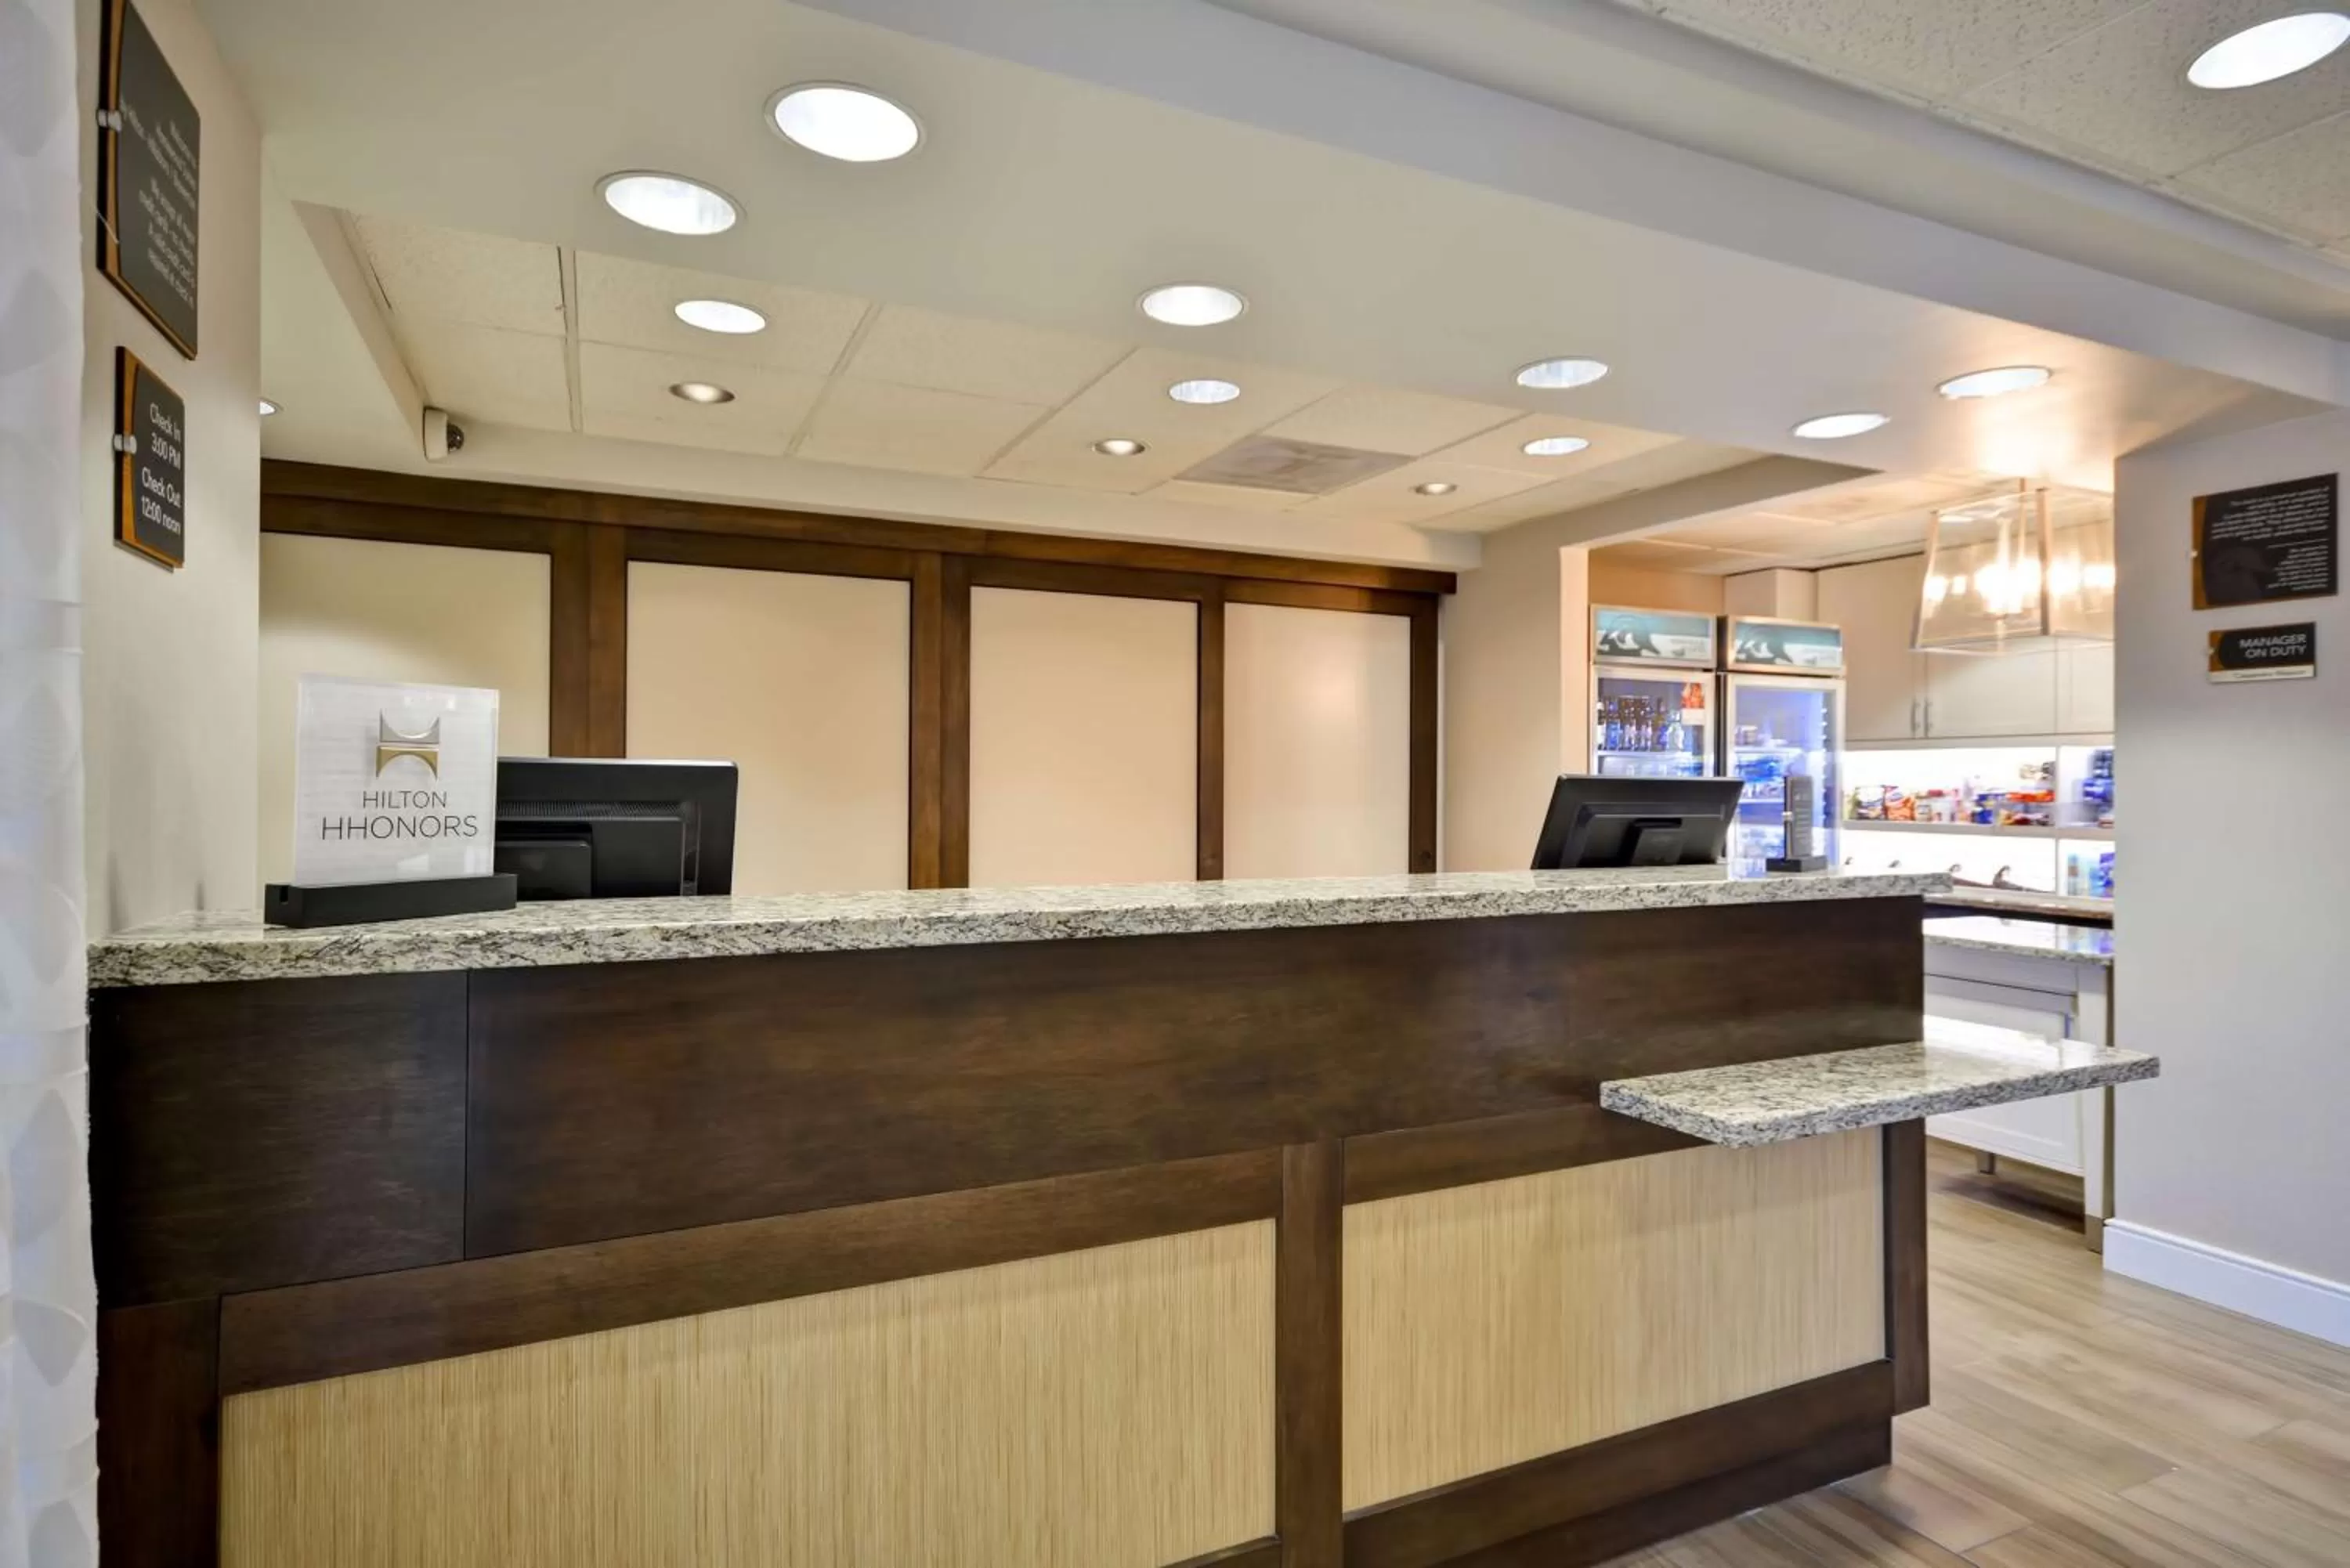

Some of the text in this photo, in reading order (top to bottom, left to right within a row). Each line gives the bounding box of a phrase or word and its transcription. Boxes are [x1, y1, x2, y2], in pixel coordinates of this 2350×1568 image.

[150, 402, 172, 436] Check
[151, 432, 181, 471] 3:00 PM
[142, 466, 181, 508] Check Out
[141, 495, 181, 536] 12:00 noon
[2239, 633, 2307, 649] MANAGER
[2245, 645, 2307, 659] ON DUTY
[363, 790, 447, 809] HILTON
[322, 815, 479, 840] HHONORS
